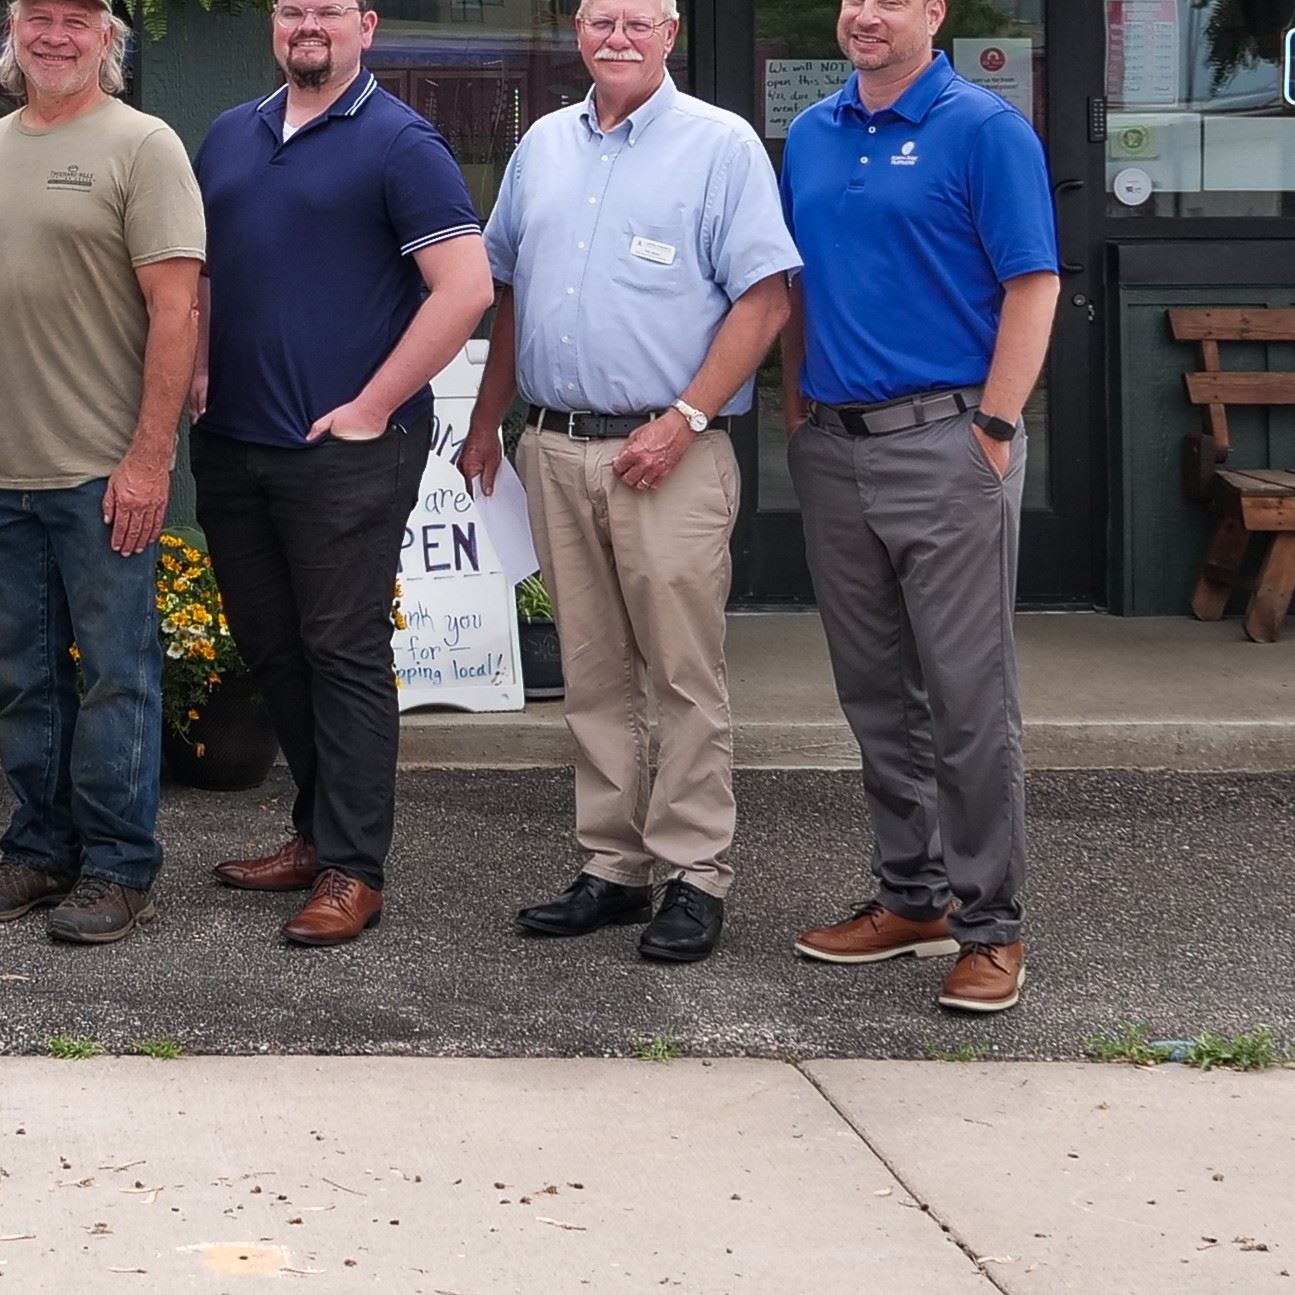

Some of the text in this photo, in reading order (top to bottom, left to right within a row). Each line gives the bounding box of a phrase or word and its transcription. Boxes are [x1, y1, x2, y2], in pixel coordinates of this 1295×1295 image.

[769, 61, 847, 74] We will NOT
[766, 78, 791, 90] open
[798, 74, 820, 86] this
[424, 488, 472, 514] are
[396, 521, 480, 573] PEN
[443, 613, 482, 647] you
[407, 635, 441, 660] for
[396, 652, 503, 685] pping local!
